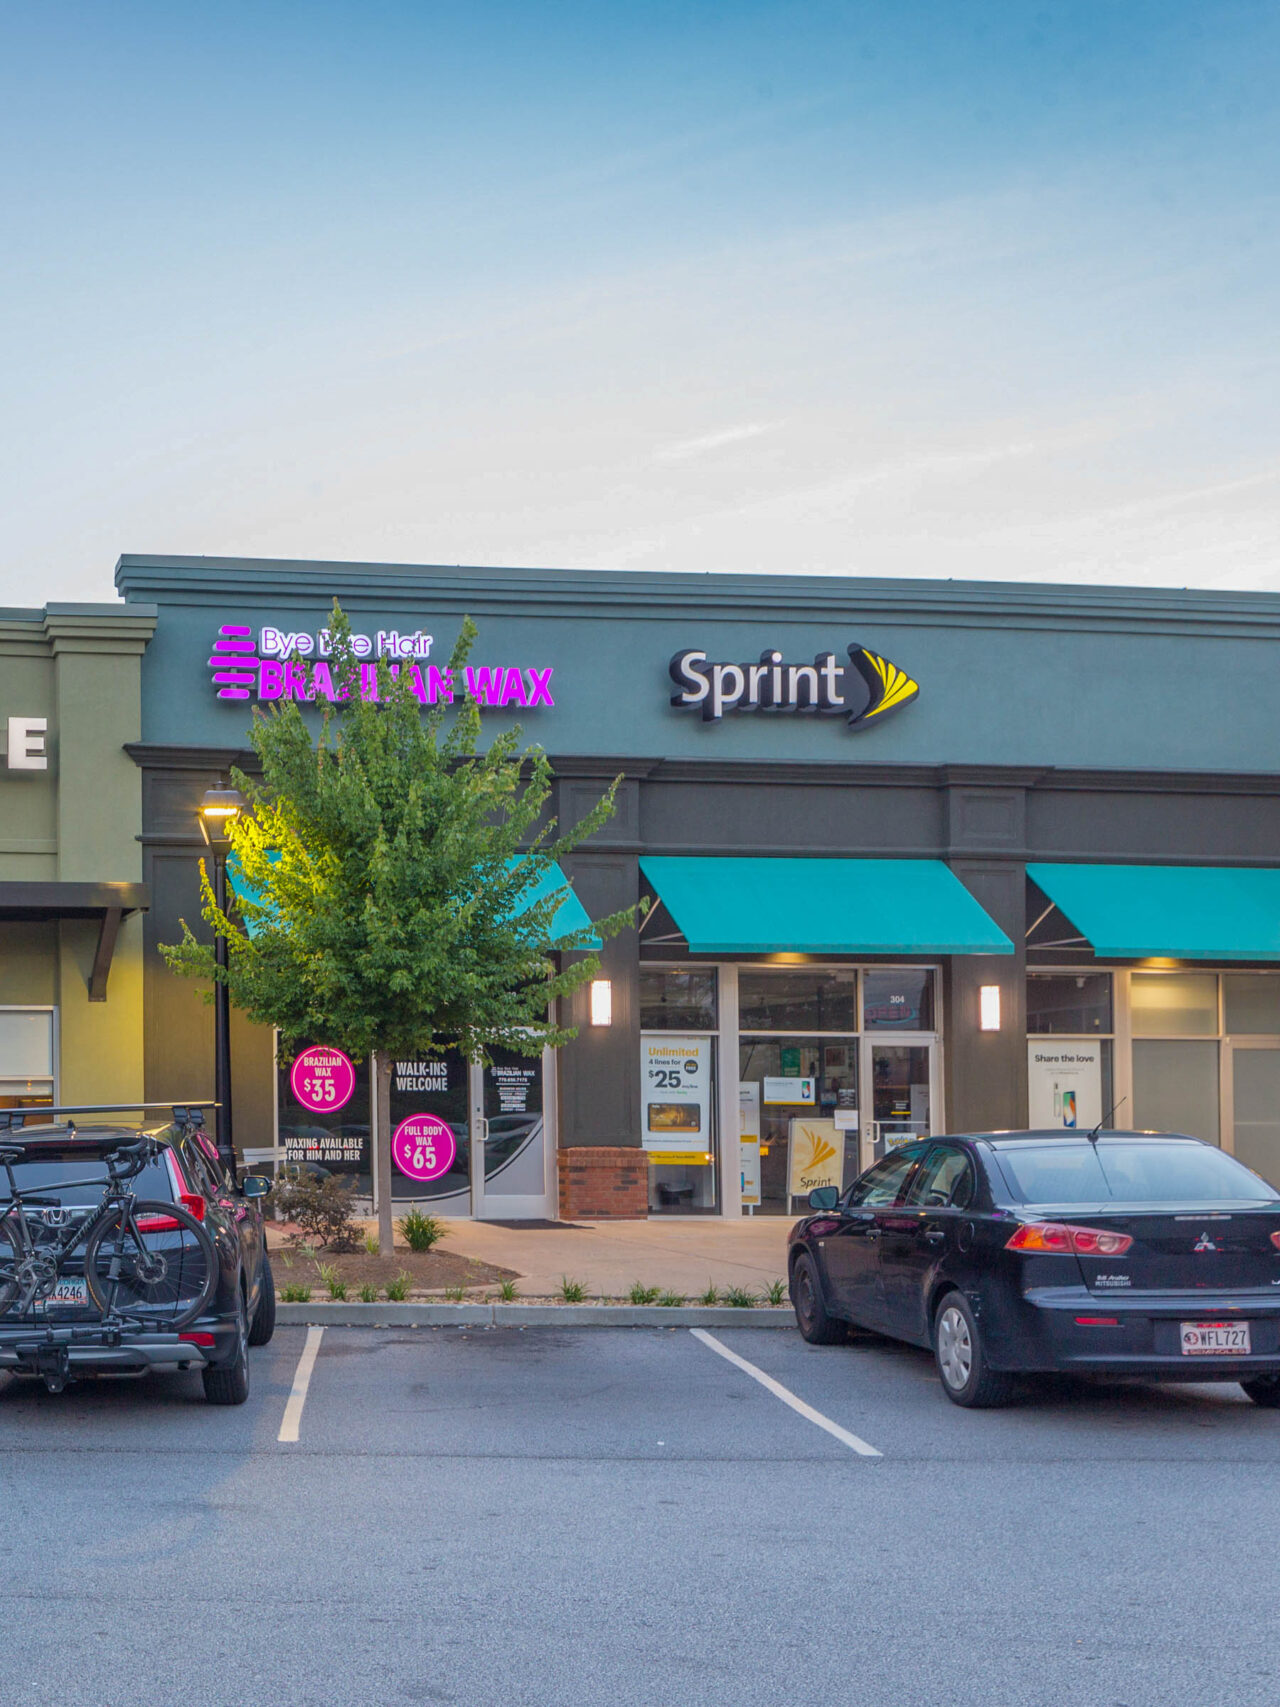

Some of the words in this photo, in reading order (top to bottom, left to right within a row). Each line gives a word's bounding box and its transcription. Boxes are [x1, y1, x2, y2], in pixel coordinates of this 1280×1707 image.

[260, 627, 315, 660] Bye
[376, 631, 434, 658] Hair
[464, 666, 554, 706] WAX
[680, 651, 844, 717] Sprint
[890, 995, 905, 1004] 304
[648, 1047, 699, 1057] Unlimited
[1035, 1054, 1059, 1063] Share
[1061, 1054, 1075, 1063] the
[1076, 1054, 1095, 1063] love
[303, 1056, 341, 1067] BRAZILIAN
[314, 1067, 332, 1077] WAX
[396, 1062, 448, 1076] WALK-INS
[396, 1077, 448, 1092] WELCOME
[648, 1069, 682, 1089] $25
[303, 1078, 336, 1102] $35
[404, 1126, 421, 1136] FULL
[423, 1126, 443, 1136] BODY
[285, 1138, 318, 1149] WAXING
[320, 1138, 363, 1149] AVAILABLE
[415, 1136, 433, 1146] WAX
[288, 1150, 304, 1161] FOR
[306, 1150, 322, 1161] HIM
[324, 1150, 341, 1161] AND
[343, 1150, 360, 1161] HER
[404, 1144, 437, 1169] $65
[800, 1176, 832, 1189] Sprint
[1199, 1330, 1246, 1346] WFL727
